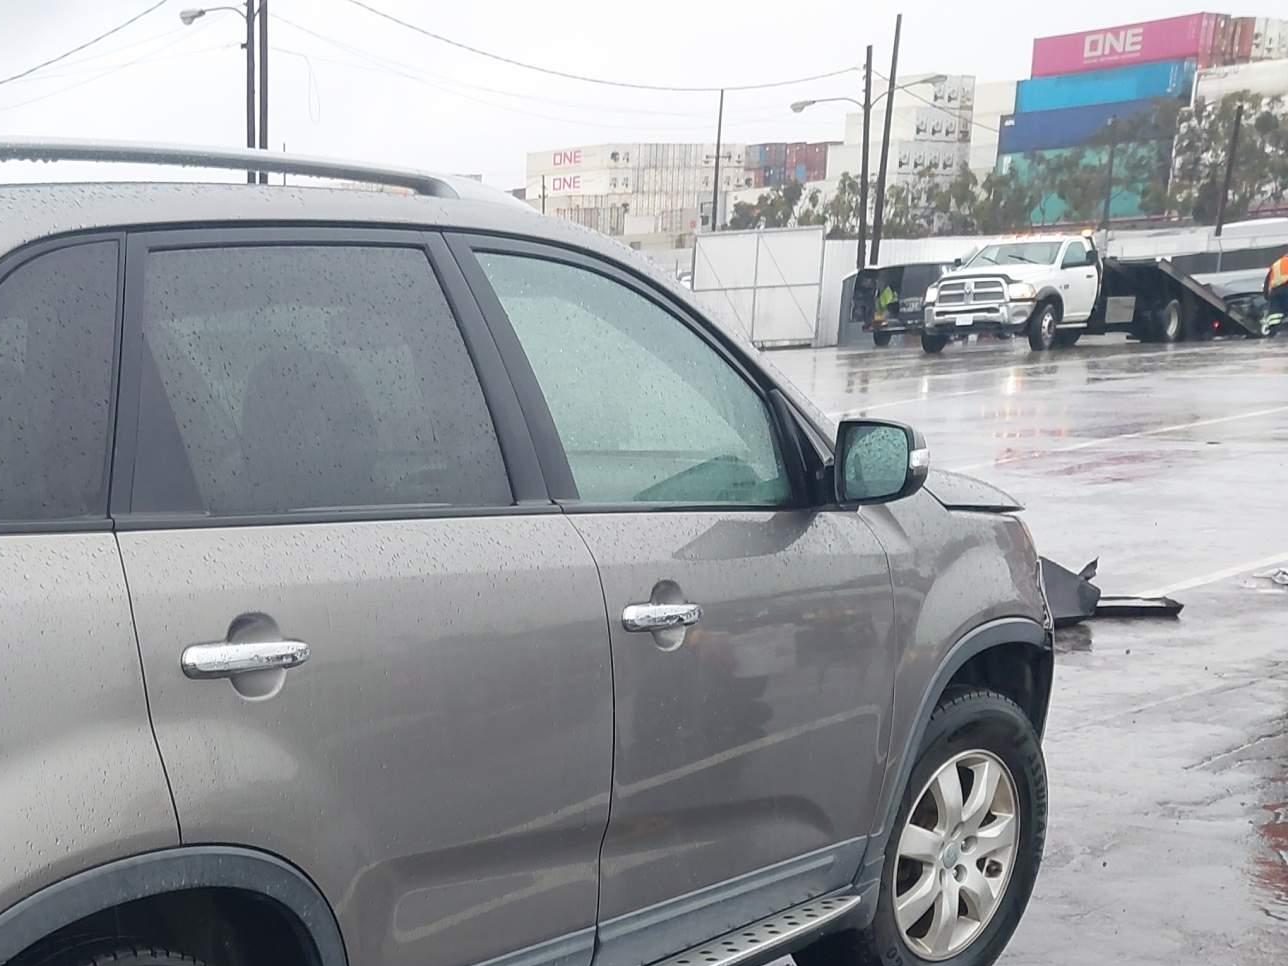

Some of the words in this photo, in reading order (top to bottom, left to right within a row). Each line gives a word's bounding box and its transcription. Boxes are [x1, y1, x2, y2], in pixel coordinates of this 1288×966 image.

[1083, 28, 1143, 58] ONE
[553, 150, 582, 166] ONE
[552, 175, 581, 192] ONE
